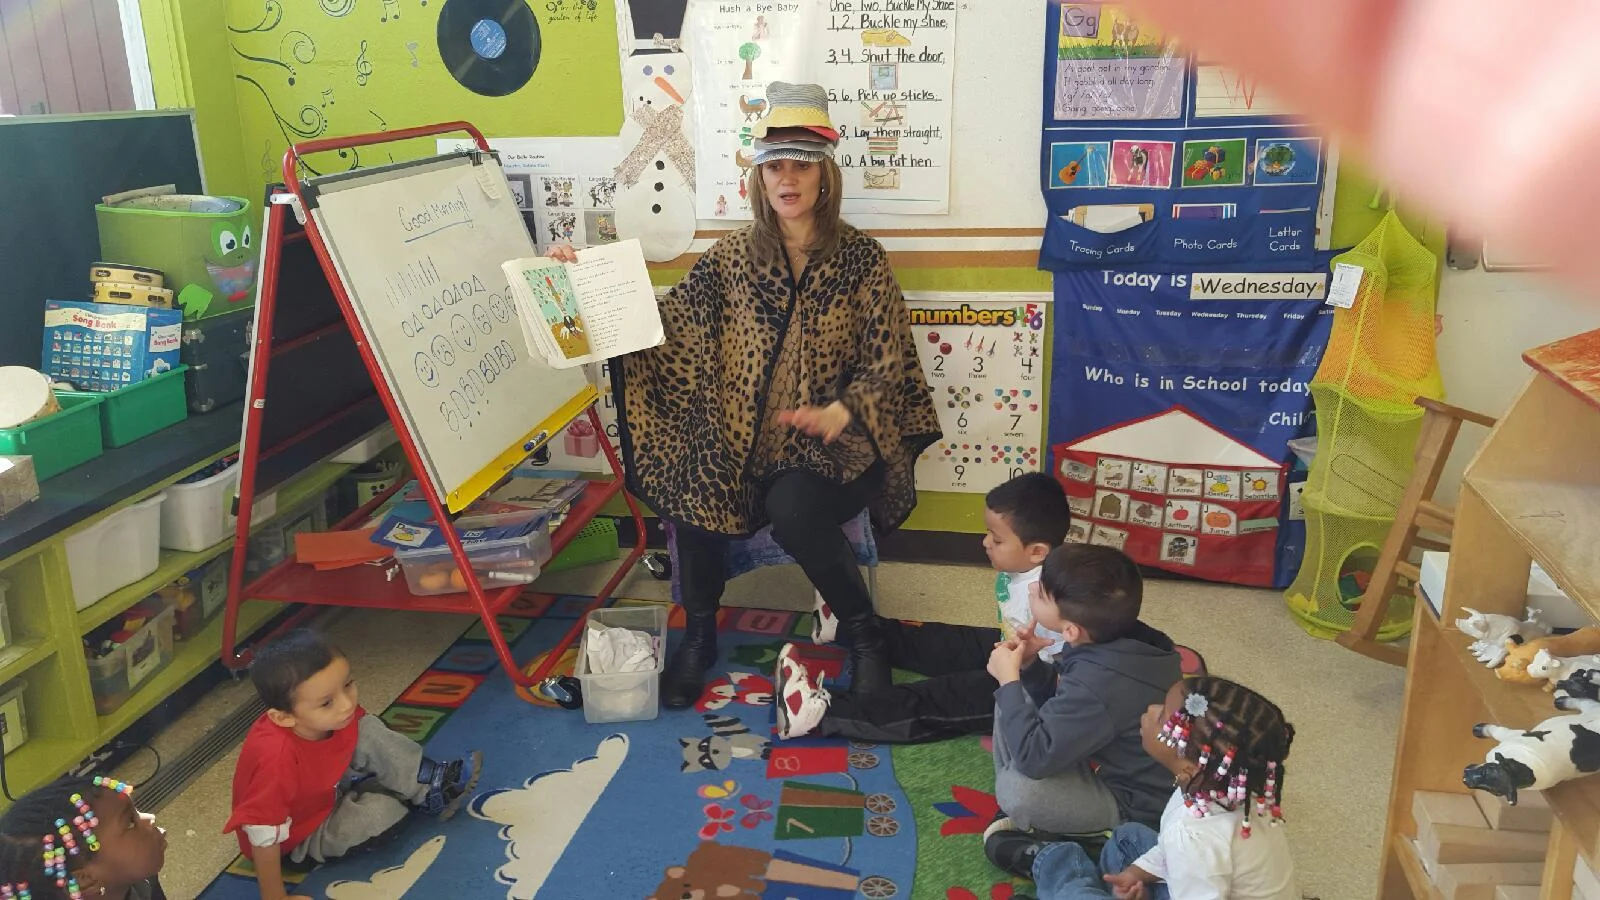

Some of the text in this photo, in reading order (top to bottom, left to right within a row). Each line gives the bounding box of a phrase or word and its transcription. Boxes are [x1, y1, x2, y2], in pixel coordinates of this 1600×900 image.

[719, 4, 741, 13] Hush
[756, 3, 773, 15] Bye
[777, 4, 799, 14] Baby
[860, 13, 901, 29] Buckle
[903, 18, 918, 36] my
[861, 47, 892, 63] Shut
[897, 47, 914, 63] the
[858, 89, 880, 100] Pick
[883, 92, 897, 105] up
[854, 126, 870, 141] Lay
[873, 126, 901, 138] them
[860, 155, 867, 167] A
[871, 155, 886, 169] big
[889, 153, 908, 168] fat
[399, 204, 432, 232] Good
[1268, 227, 1303, 238] Letter
[1069, 240, 1135, 260] Tracing Cards
[1174, 238, 1238, 250] Photo Cards
[1269, 240, 1301, 251] Cards
[1101, 270, 1162, 292] Today
[1170, 272, 1187, 287] is
[1199, 277, 1318, 298] Wednesday
[910, 305, 1016, 327] numbers
[1082, 303, 1103, 312] Sunday
[1116, 307, 1141, 317] Monday
[1155, 309, 1182, 318] Tuesday
[1191, 311, 1229, 319] Wednesday
[1236, 312, 1268, 320] Thursday
[1283, 313, 1305, 321] Friday
[72, 314, 93, 328] Song
[95, 318, 117, 329] Bank
[933, 355, 1033, 374] 2 3 4
[1085, 366, 1124, 385] Who
[1135, 373, 1150, 387] is
[1159, 376, 1175, 390] in
[1182, 376, 1248, 392] School
[957, 412, 1023, 430] 6 7
[954, 465, 965, 480] 9
[1206, 471, 1214, 479] D
[1244, 472, 1252, 483] S
[786, 818, 815, 834] 7
